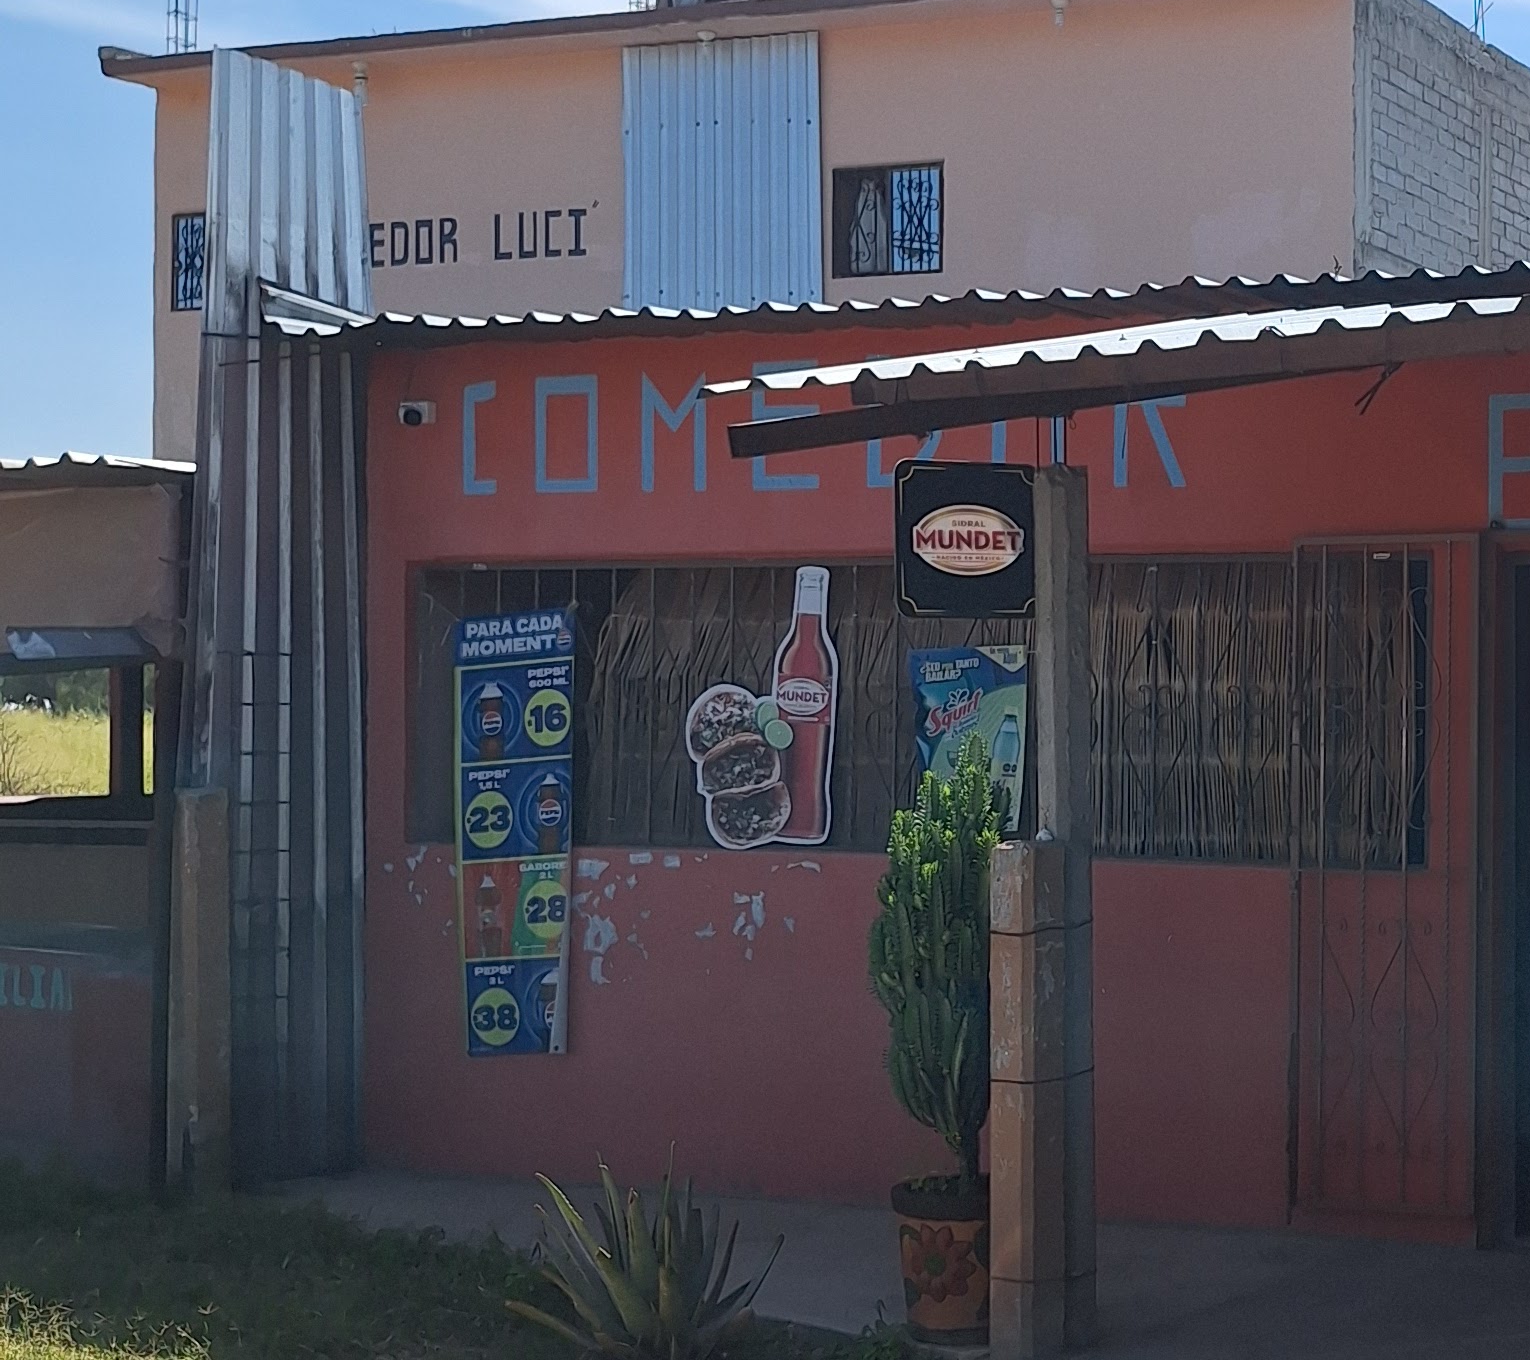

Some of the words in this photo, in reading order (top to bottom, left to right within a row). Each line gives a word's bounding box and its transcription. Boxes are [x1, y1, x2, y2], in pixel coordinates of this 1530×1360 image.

[368, 217, 459, 269] EDOR
[951, 519, 986, 528] SIDRAL
[915, 528, 1021, 552] MUNDET
[465, 618, 513, 639] PARA
[516, 614, 563, 634] CADA
[776, 690, 827, 704] MUNDET
